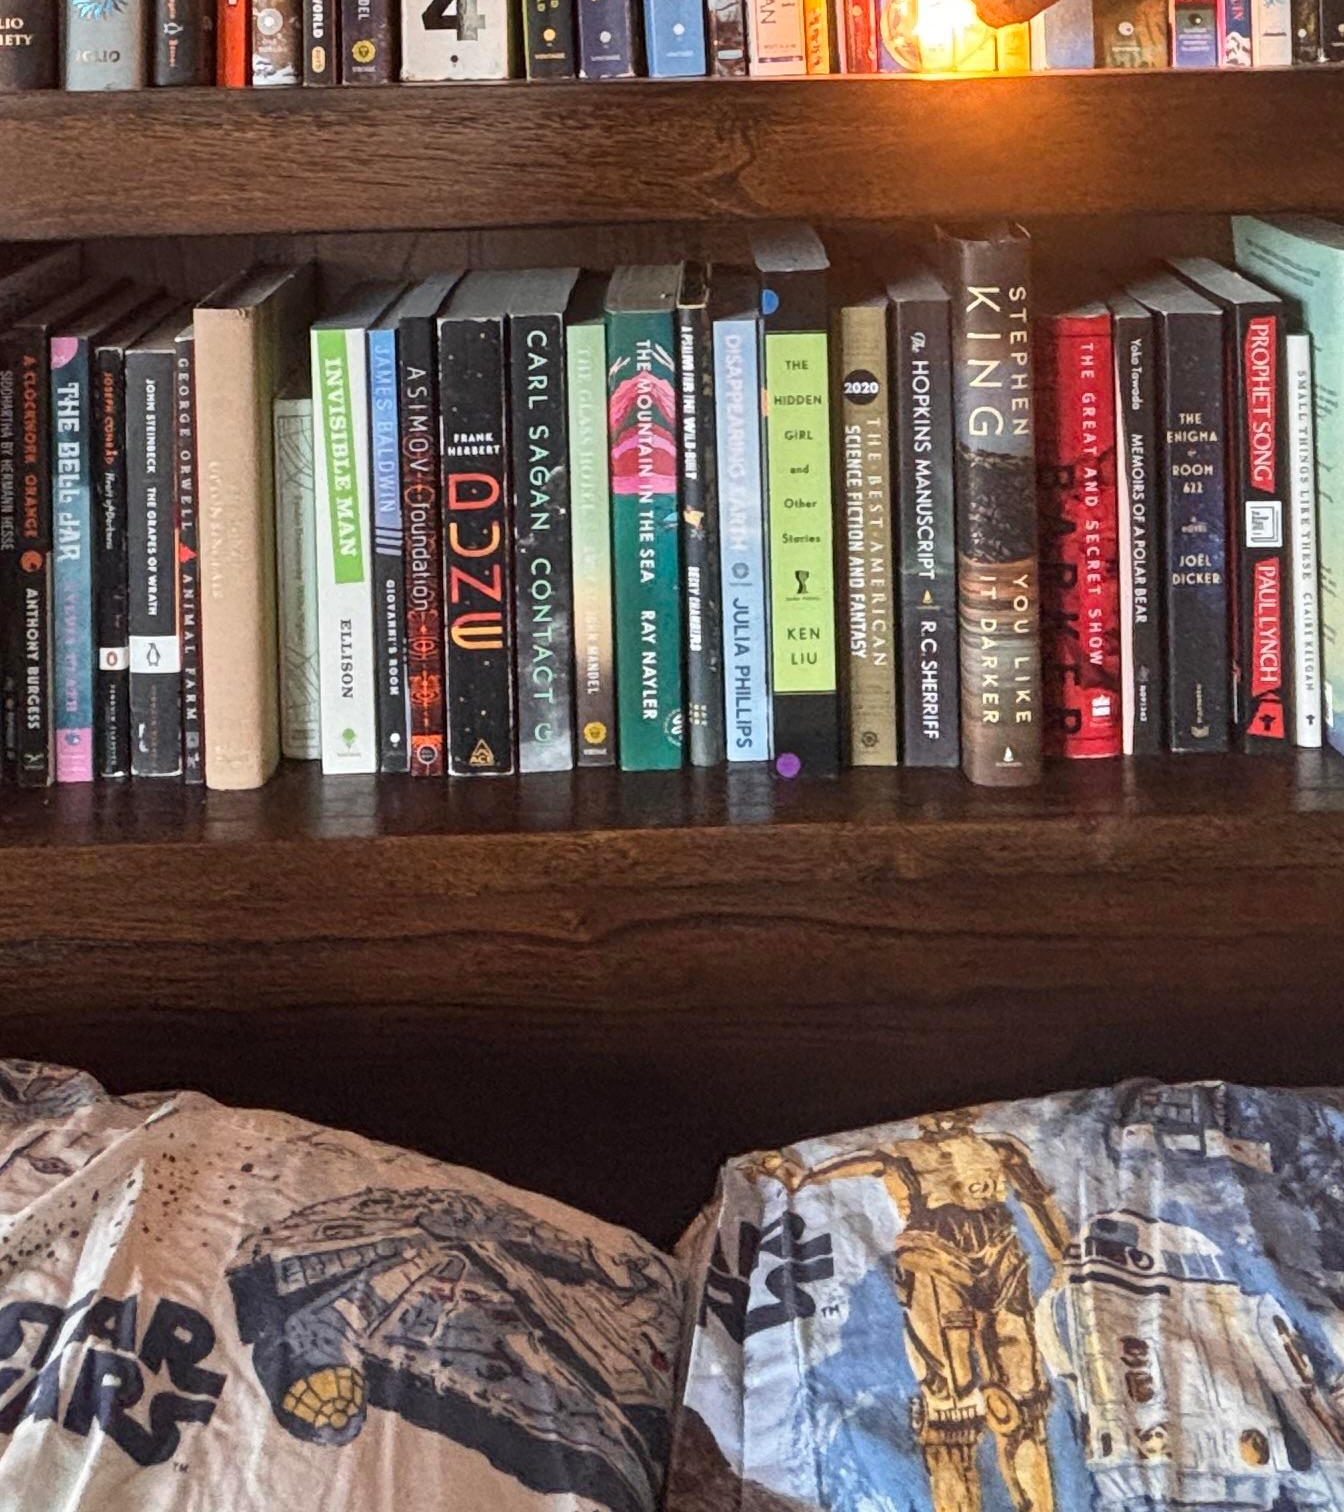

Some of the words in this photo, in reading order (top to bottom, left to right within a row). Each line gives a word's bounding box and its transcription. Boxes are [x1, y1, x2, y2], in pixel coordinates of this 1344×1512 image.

[525, 330, 548, 410] CARL
[785, 359, 809, 371] THE
[966, 285, 1004, 436] KING
[1008, 286, 1030, 435] STEPHEN
[1080, 343, 1094, 380] THE
[1251, 324, 1272, 419] PROPHET
[56, 382, 80, 433] THE
[774, 394, 823, 407] HIDDEN
[844, 381, 879, 395] 2020
[325, 358, 353, 490] INVISIBLE
[406, 367, 430, 473] ASIMOV
[453, 433, 494, 444] FRANK
[784, 429, 814, 441] GIRL
[1081, 393, 1097, 456] GREAT
[1166, 431, 1218, 443] ENIGMA
[1179, 413, 1202, 425] THE
[57, 441, 81, 505] BELL
[447, 444, 500, 456] HERBERT
[789, 464, 810, 475] and
[1173, 464, 1214, 476] ROOM
[1253, 421, 1273, 482] SONG
[528, 425, 551, 532] SAGAN
[783, 498, 818, 510] Other
[1083, 468, 1099, 507] AND
[57, 512, 81, 561] JAR
[332, 494, 357, 558] MAN
[782, 533, 822, 544] Stories
[409, 501, 430, 612] foundation
[1085, 519, 1101, 596] SECRET
[1173, 571, 1222, 585] DICKER
[1179, 552, 1212, 567] JOËL
[981, 575, 997, 601] IT
[1012, 574, 1029, 634] YOU
[1257, 566, 1277, 619] PAUL
[529, 557, 554, 704] CONTACT
[787, 627, 821, 641] KEN
[1087, 609, 1103, 666] SHOW
[1259, 621, 1279, 683] LYNCH
[340, 618, 354, 699] ELLISON
[790, 652, 818, 665] LIU
[981, 617, 1000, 724] DARKER
[1013, 655, 1032, 724] LIKE
